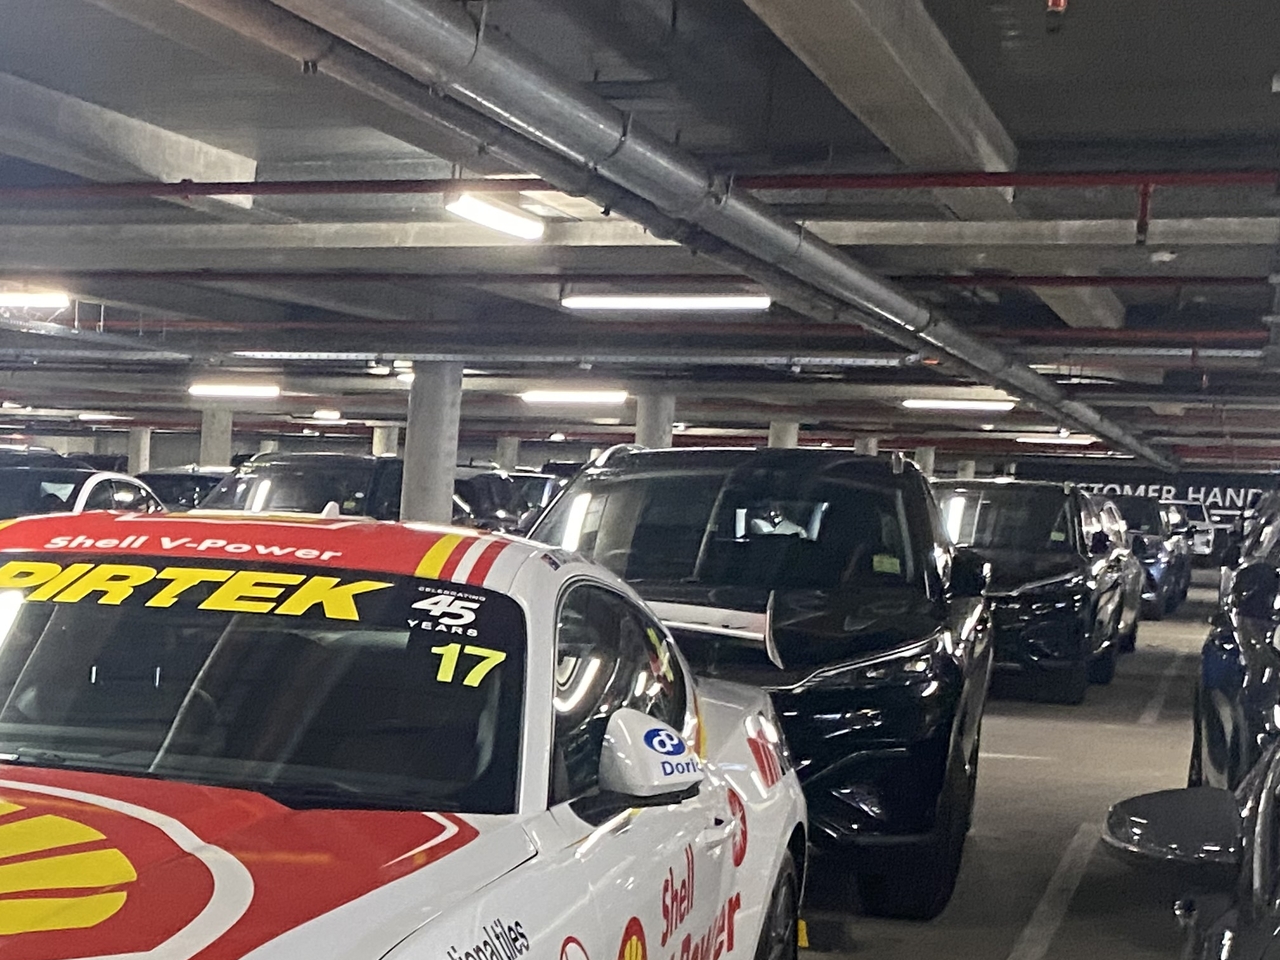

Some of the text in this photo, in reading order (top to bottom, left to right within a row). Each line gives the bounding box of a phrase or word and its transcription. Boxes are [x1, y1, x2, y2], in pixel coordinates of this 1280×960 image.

[44, 535, 343, 561] Shell V-Power
[418, 586, 486, 602] CELEBRATING
[411, 594, 480, 626] 45
[407, 619, 478, 637] YEARS
[431, 642, 507, 688] 17
[661, 843, 695, 947] Shell
